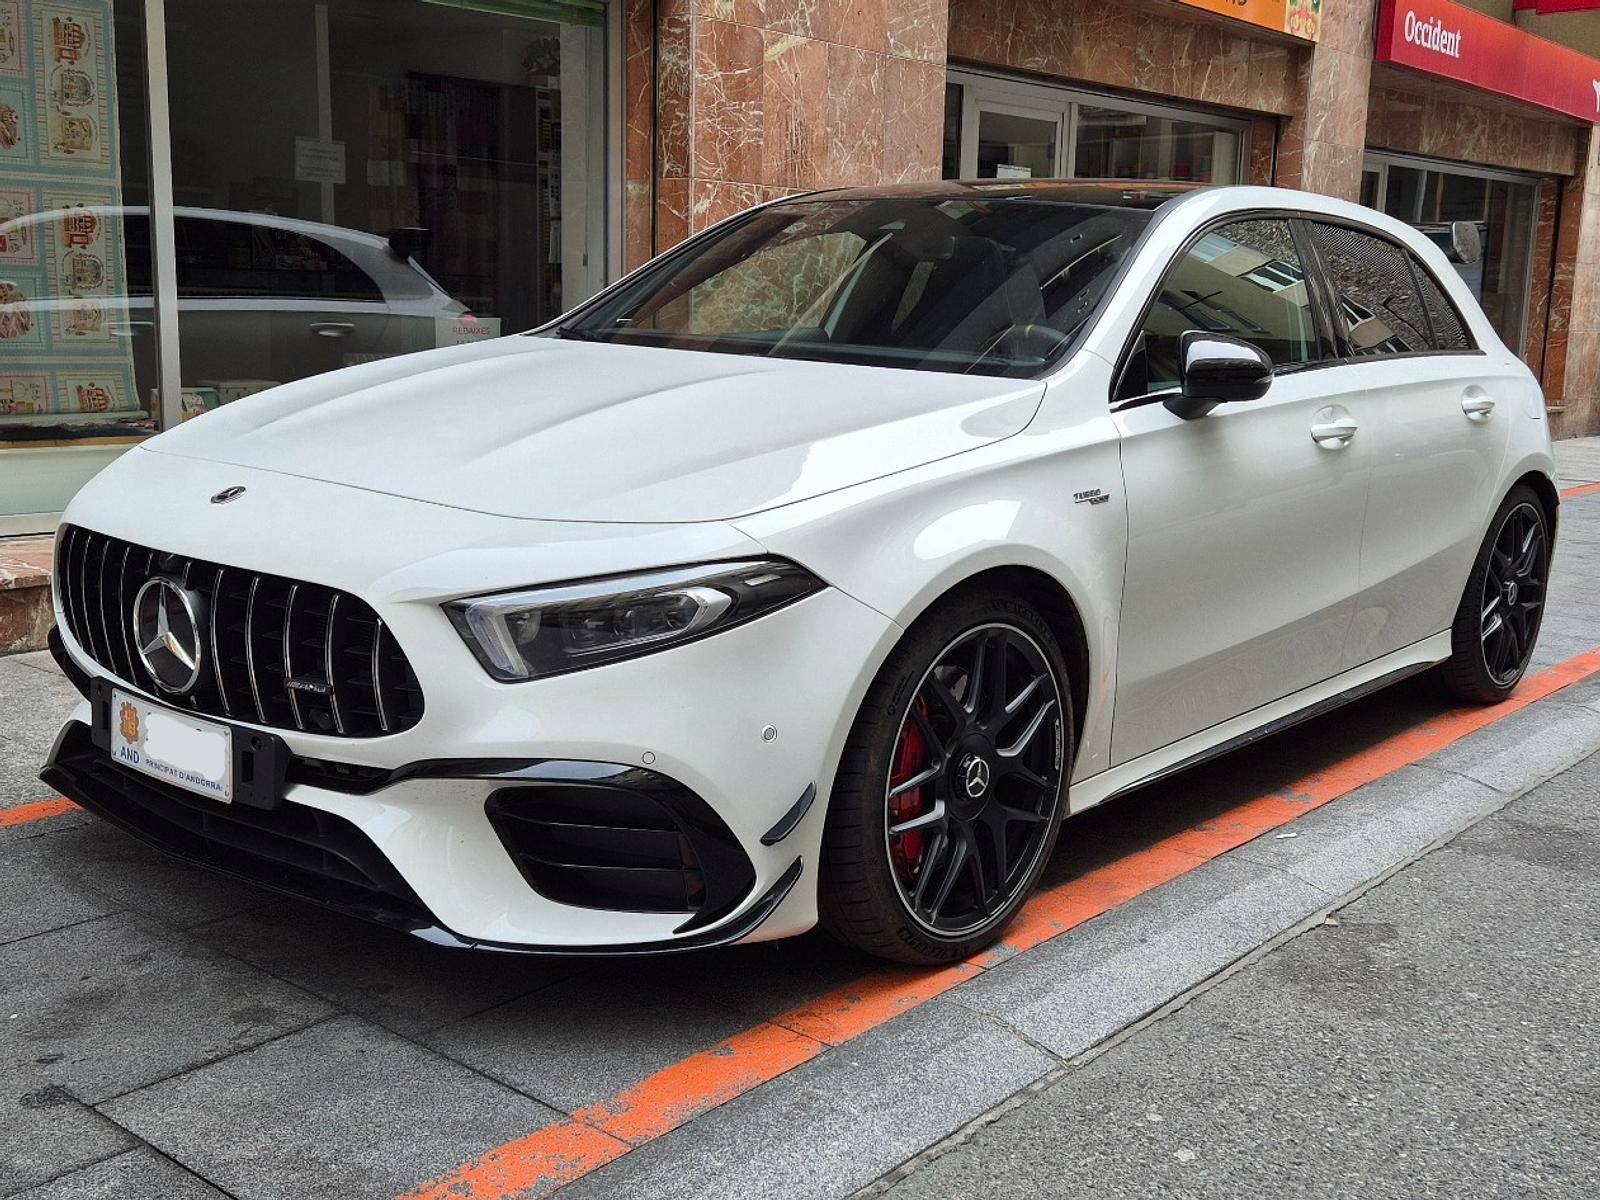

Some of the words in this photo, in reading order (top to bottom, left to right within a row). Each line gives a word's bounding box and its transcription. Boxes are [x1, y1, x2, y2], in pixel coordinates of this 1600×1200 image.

[1404, 10, 1462, 58] Occident
[120, 746, 140, 764] AND
[145, 758, 179, 778] PRINCIPAT
[179, 770, 222, 791] D'ANDORRA
